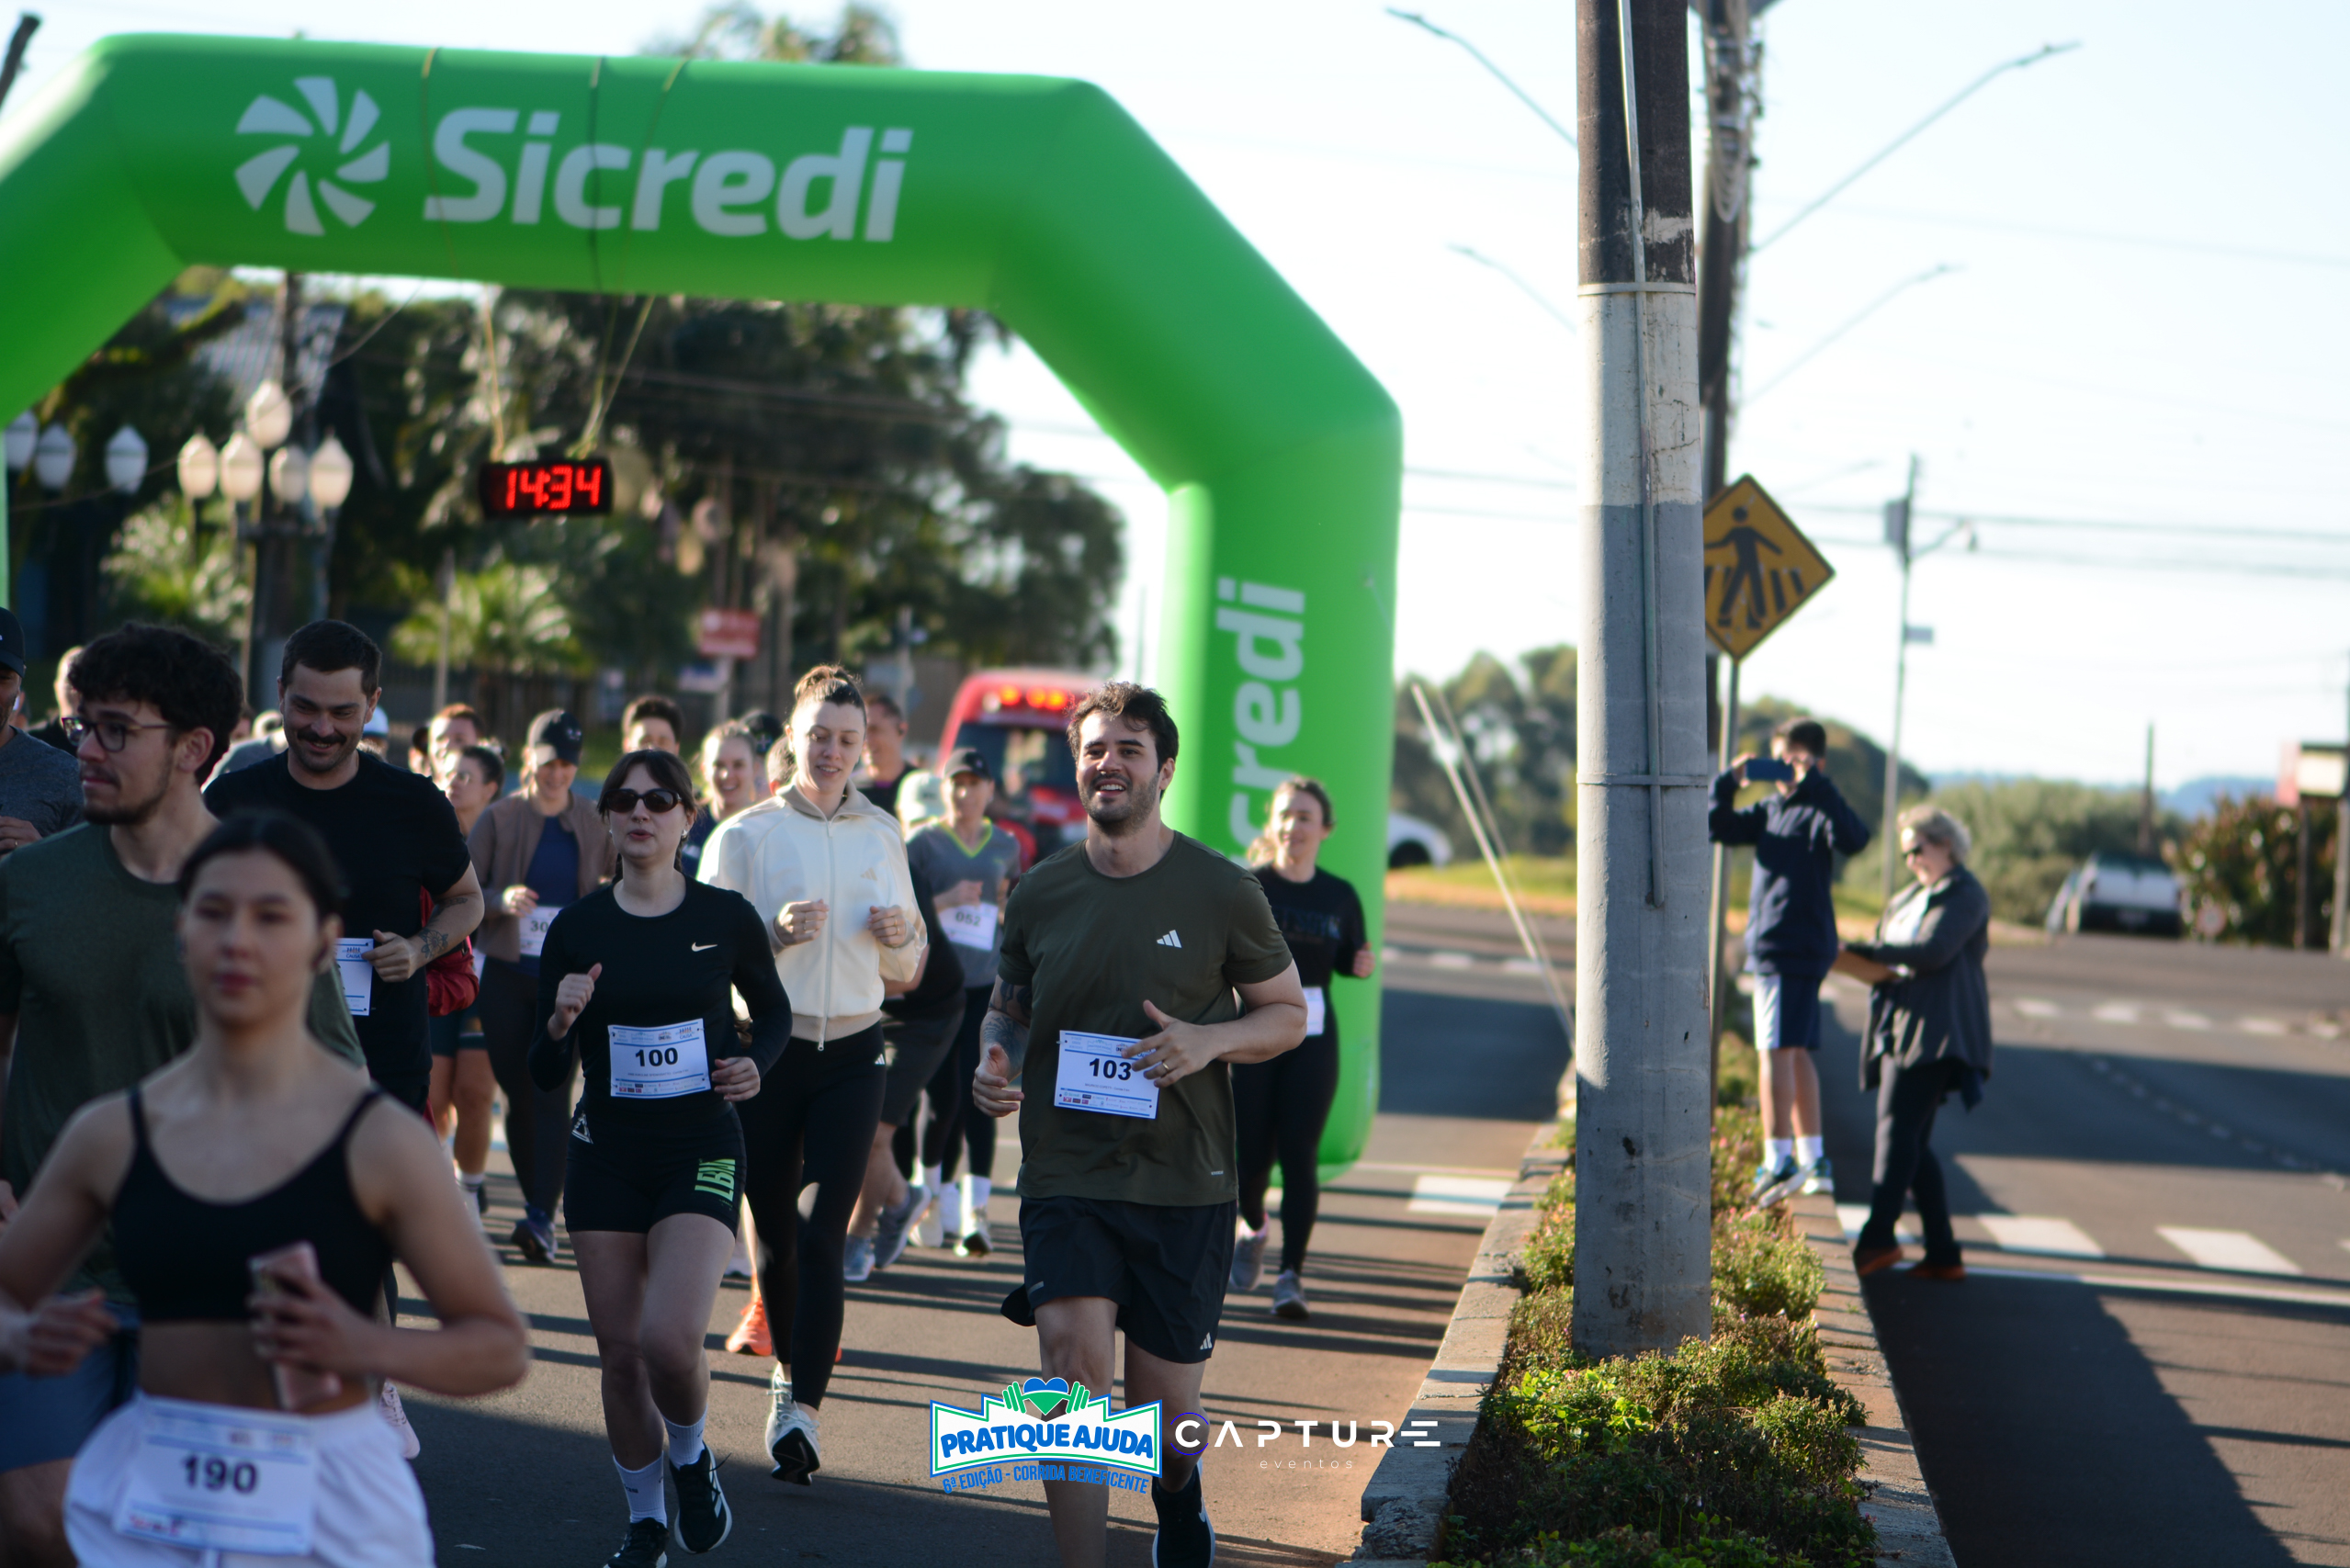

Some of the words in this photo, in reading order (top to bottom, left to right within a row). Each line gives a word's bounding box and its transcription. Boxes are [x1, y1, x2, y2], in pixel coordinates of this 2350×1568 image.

[424, 107, 914, 243] Sicredi
[506, 464, 602, 510] 14:34
[1215, 576, 1305, 868] credi
[530, 920, 549, 933] 30
[955, 911, 981, 927] 052
[635, 1047, 678, 1067] 100
[1089, 1057, 1132, 1081] 103
[182, 1453, 258, 1493] 190
